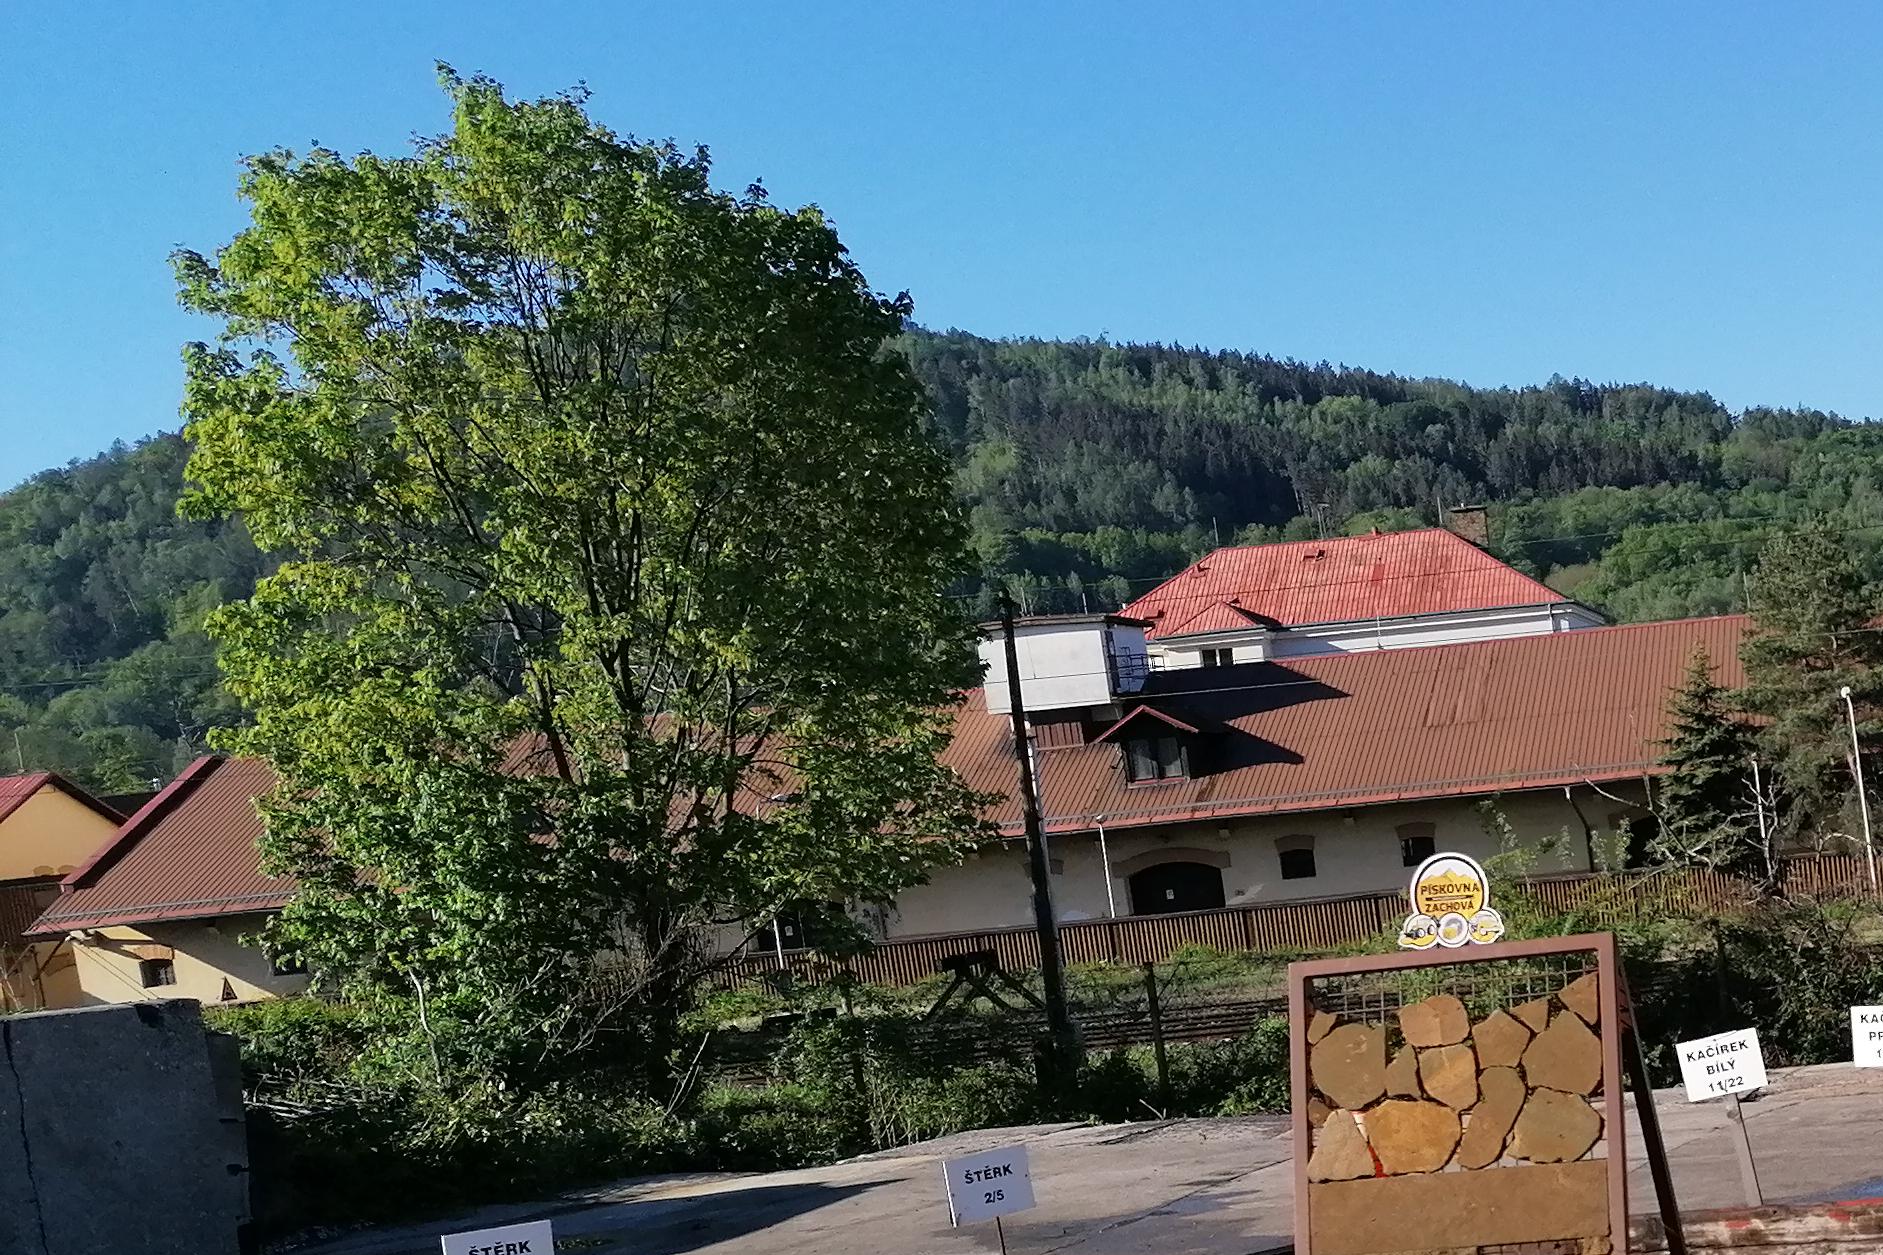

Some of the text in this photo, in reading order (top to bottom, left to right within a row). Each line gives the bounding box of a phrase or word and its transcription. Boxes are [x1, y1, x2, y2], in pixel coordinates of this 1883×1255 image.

[1420, 882, 1480, 895] PÍSKOVNA
[1686, 1040, 1749, 1063] KAČÍREK
[1706, 1057, 1736, 1075] BÍLÝ
[1709, 1076, 1744, 1092] 11/22
[964, 1163, 1013, 1184] ŠTĚRK
[984, 1189, 1005, 1204] 2/5
